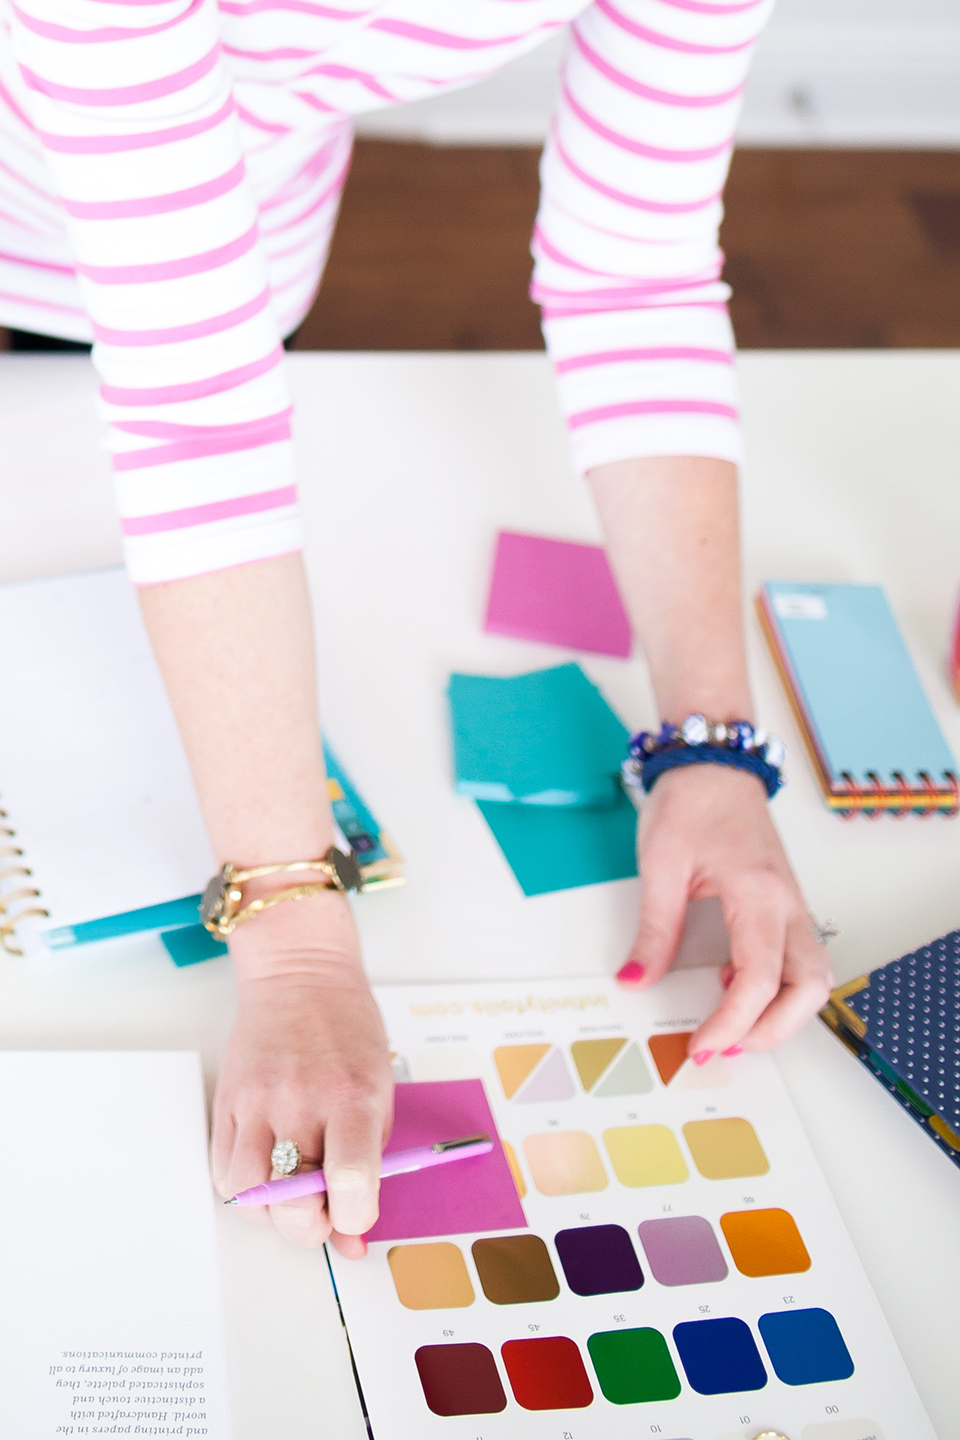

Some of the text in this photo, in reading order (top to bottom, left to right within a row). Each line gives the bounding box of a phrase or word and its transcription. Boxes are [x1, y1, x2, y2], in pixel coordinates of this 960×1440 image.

[410, 993, 608, 1016] infinityfoils.com
[782, 1295, 796, 1305] 23
[698, 1304, 711, 1314] 25
[612, 1313, 627, 1323] 35
[527, 1323, 541, 1332] 45
[442, 1329, 455, 1338] 49
[61, 1351, 202, 1361] printed communications.
[49, 1366, 63, 1375] all
[79, 1364, 115, 1375] luxury
[116, 1365, 128, 1375] of
[131, 1365, 163, 1373] image
[183, 1367, 203, 1376] add
[56, 1379, 204, 1391] sophisticated palette, they
[73, 1396, 94, 1405] and
[99, 1396, 130, 1405] touch
[134, 1397, 195, 1406] distinctive
[824, 1404, 840, 1415] 00
[71, 1410, 206, 1421] world. Handcrafted with
[739, 1415, 751, 1425] 01
[56, 1425, 208, 1437] and printing papers in the
[649, 1424, 662, 1434] 10
[562, 1431, 574, 1440] 12
